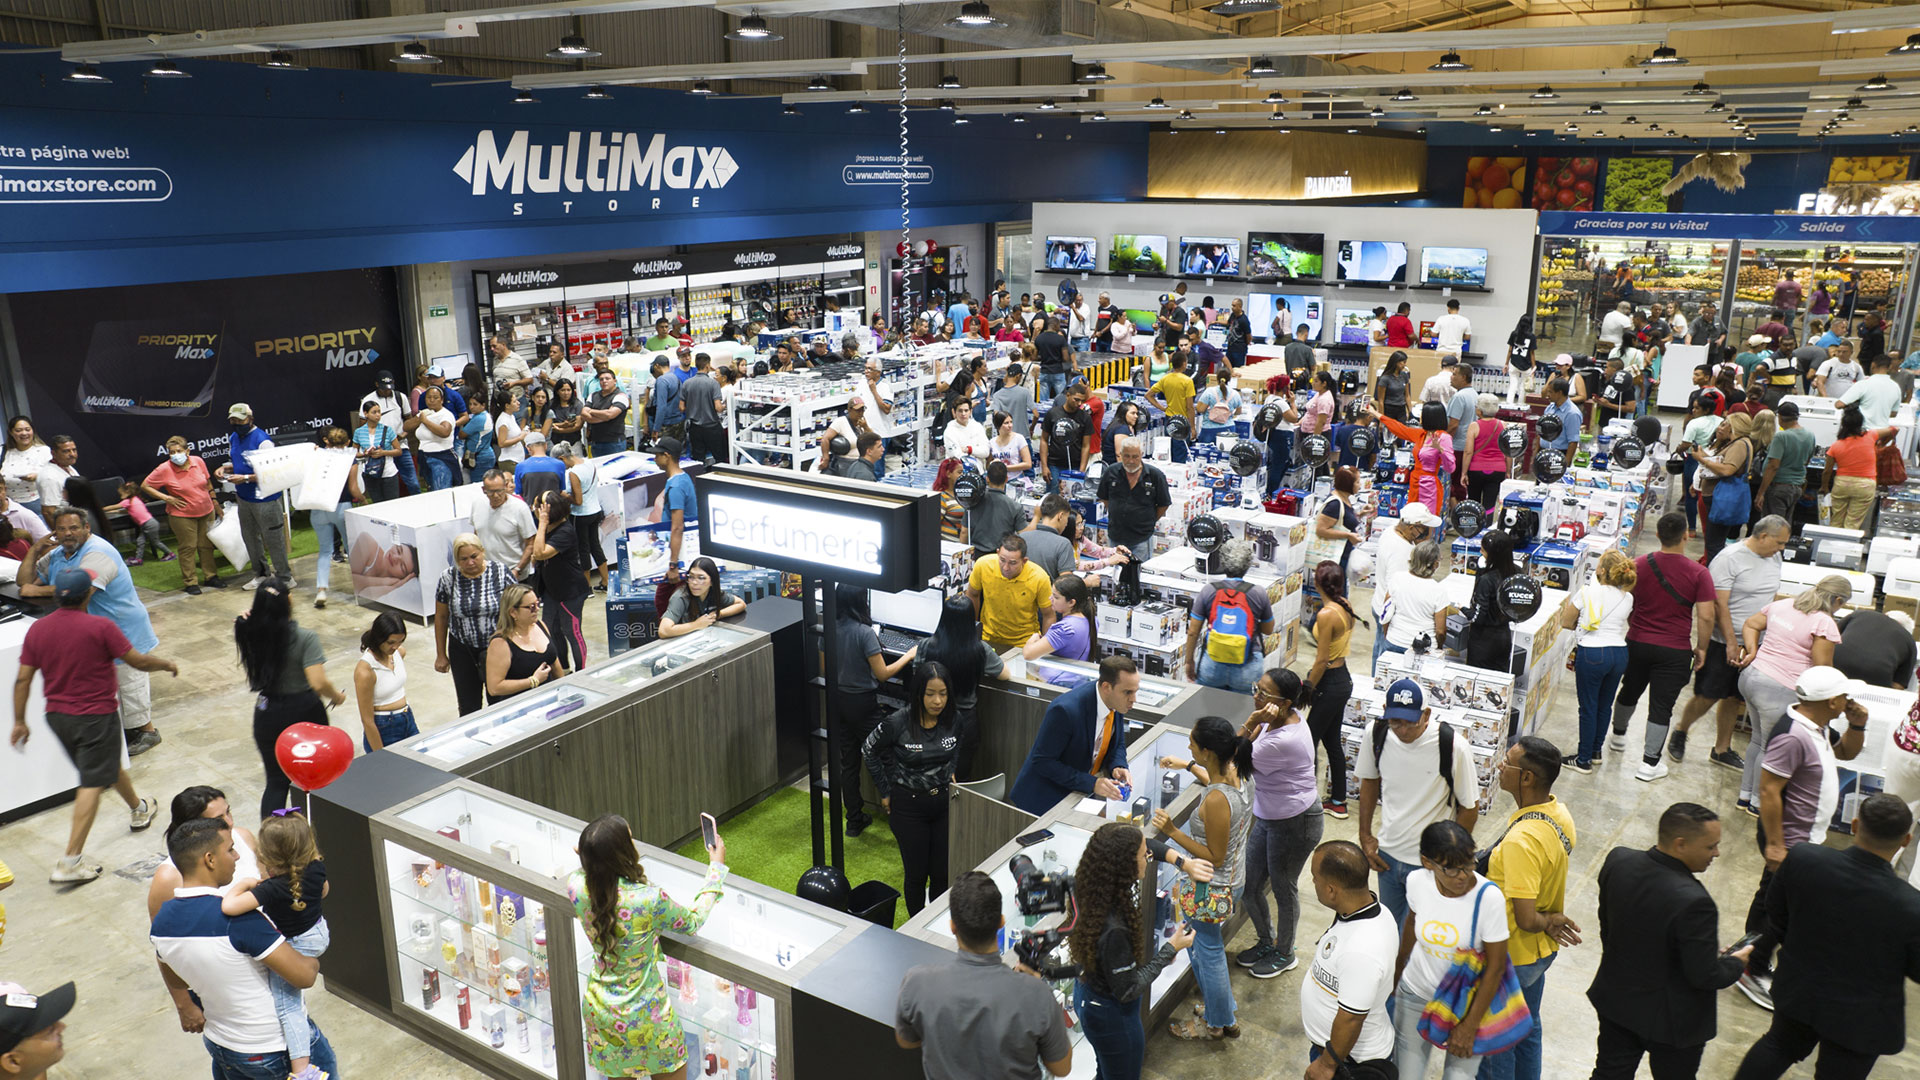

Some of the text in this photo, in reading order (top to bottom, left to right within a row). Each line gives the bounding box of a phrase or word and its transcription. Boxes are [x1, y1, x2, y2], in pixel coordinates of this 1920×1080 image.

[0, 146, 130, 161] tra página web!
[472, 130, 722, 195] MultiMax
[513, 196, 700, 216] STORE
[1574, 218, 1709, 231] ¡Gracias por su visita!
[1799, 222, 1846, 233] Salida
[635, 260, 677, 275] MultiMax
[500, 270, 552, 286] MultiMax
[138, 334, 217, 346] PRIORITY
[255, 327, 377, 358] PRIORITY
[175, 346, 209, 360] Max
[325, 348, 371, 371] Max
[85, 396, 131, 407] MultiMax
[613, 622, 646, 639] 32
